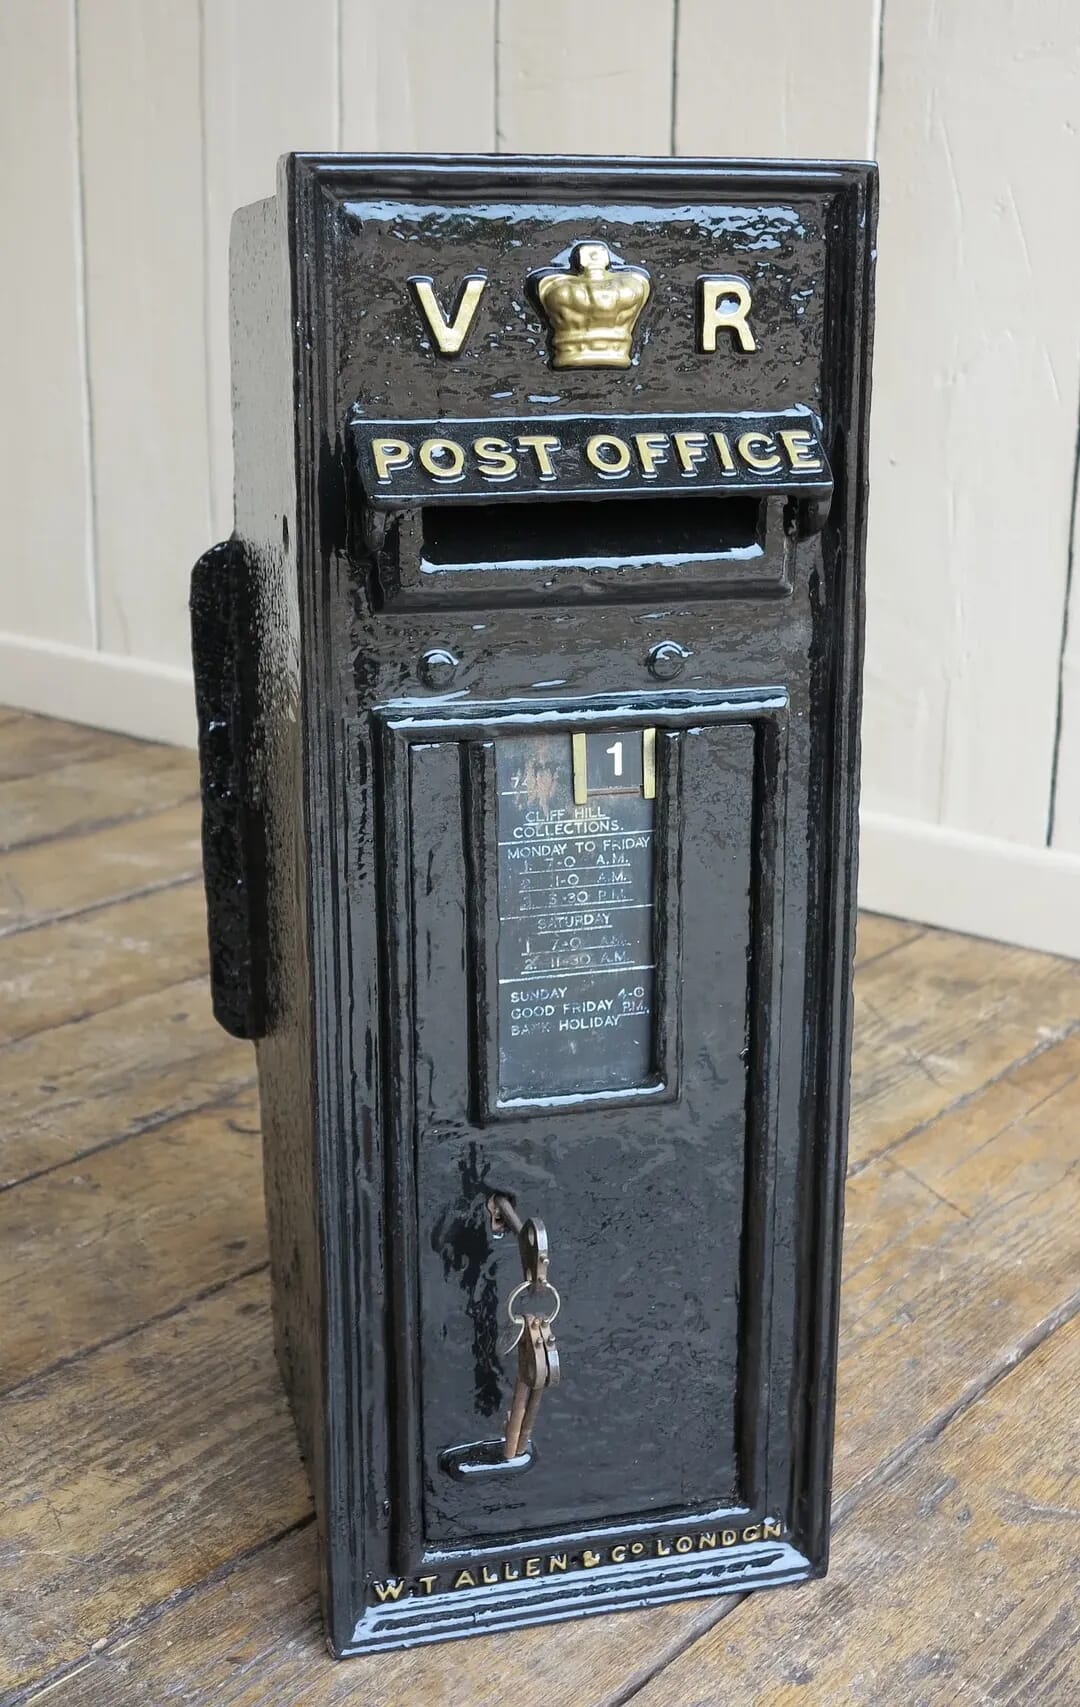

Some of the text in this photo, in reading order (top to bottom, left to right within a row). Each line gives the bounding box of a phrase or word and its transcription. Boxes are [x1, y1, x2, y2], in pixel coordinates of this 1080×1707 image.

[408, 274, 758, 356] V R
[371, 429, 824, 484] POST OFFICE
[606, 741, 623, 776] 1
[525, 806, 606, 823] CLIFF HILL
[513, 820, 624, 839] COLLECTIONS.
[507, 836, 651, 860] MONDAY TO FRIDAY
[537, 913, 612, 930] SATURDAY
[510, 986, 568, 1003] SUNDAY
[511, 1000, 614, 1020] GOOD FRIDAY
[559, 1015, 620, 1032] HOLIDAY
[454, 1553, 567, 1589] ALLEN
